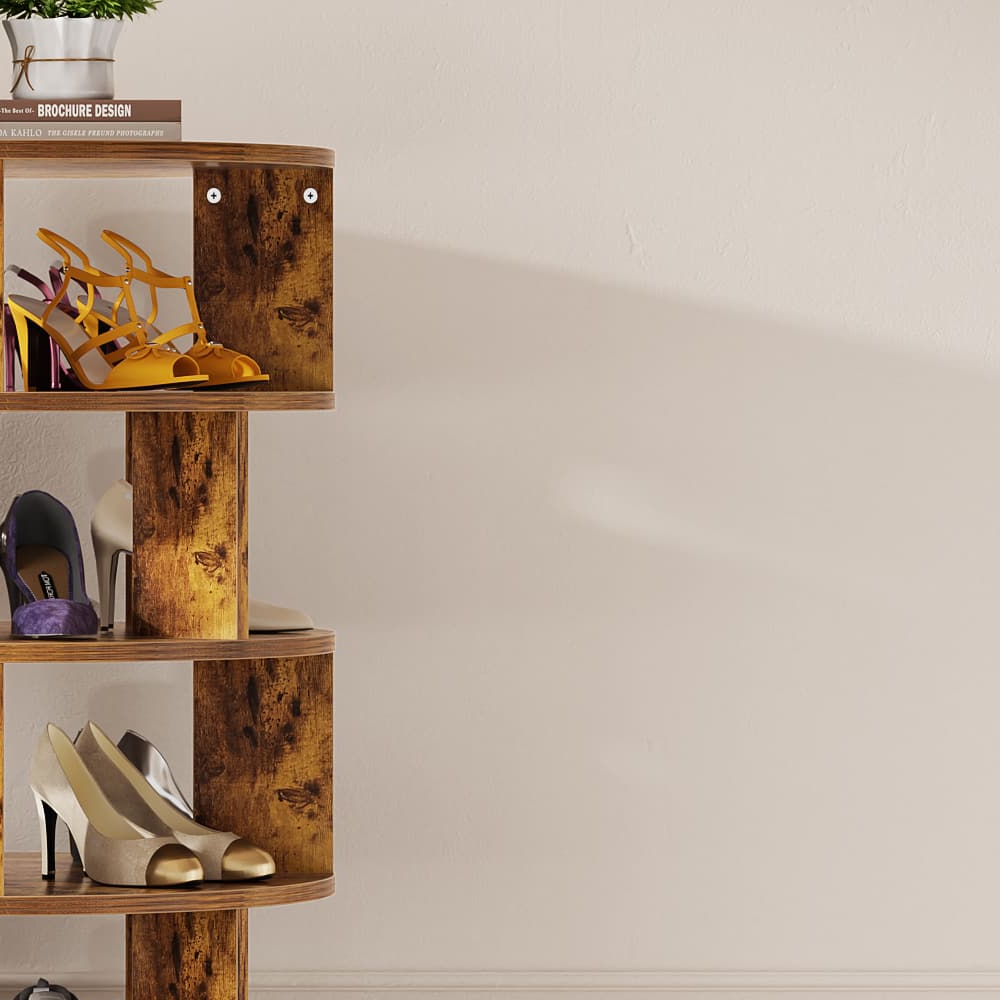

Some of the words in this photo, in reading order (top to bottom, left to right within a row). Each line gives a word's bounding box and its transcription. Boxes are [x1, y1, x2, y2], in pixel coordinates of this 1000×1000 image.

[37, 103, 92, 118] BROCHURE
[94, 103, 132, 118] DESIGN
[11, 128, 42, 137] KAHLO
[48, 129, 61, 137] THE
[115, 129, 164, 137] PHOTOGRAPHS
